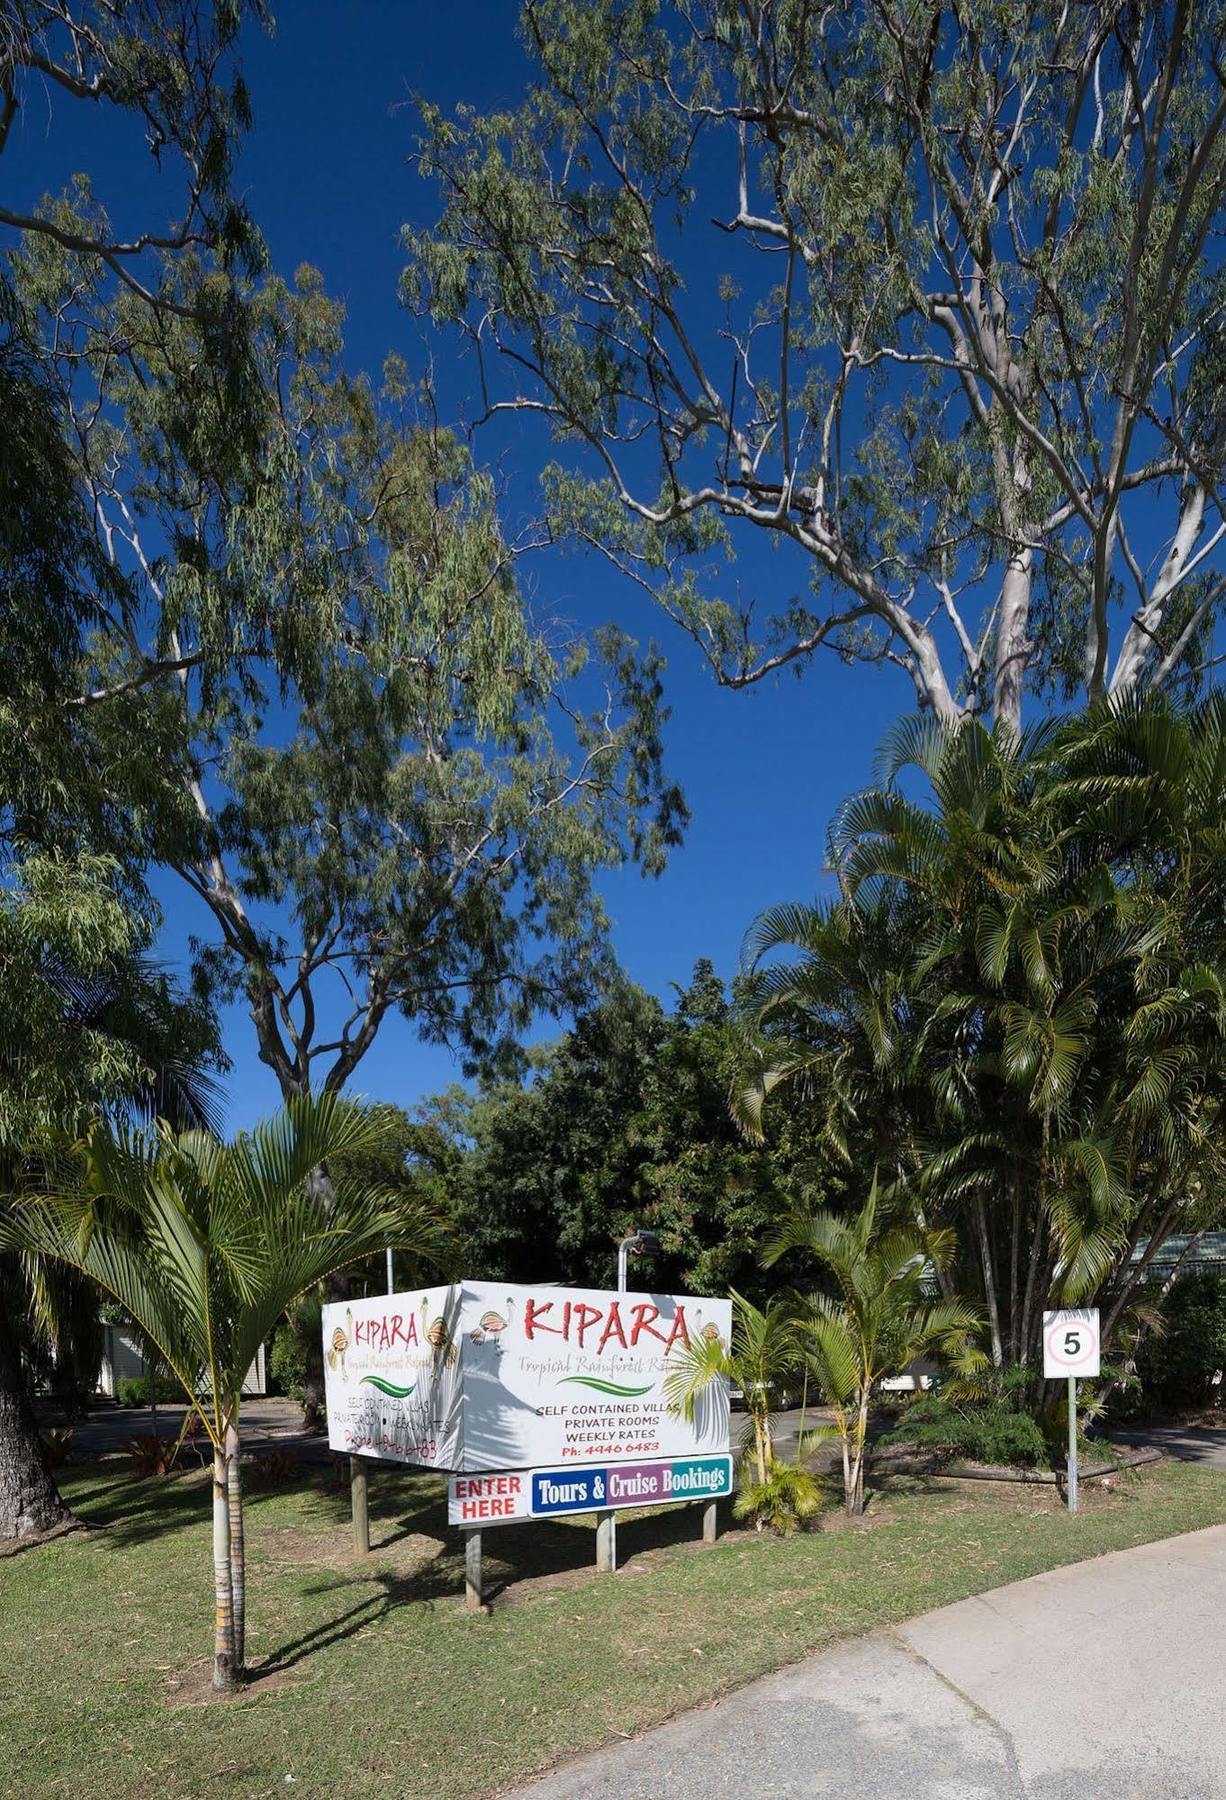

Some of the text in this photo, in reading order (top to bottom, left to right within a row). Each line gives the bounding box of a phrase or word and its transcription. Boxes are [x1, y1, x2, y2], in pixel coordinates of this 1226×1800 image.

[355, 1312, 418, 1353] KIPARA
[524, 1299, 692, 1356] KIPARA
[1064, 1331, 1081, 1355] 5
[519, 1354, 570, 1386] Tropical
[577, 1354, 643, 1379] Rainforest
[535, 1402, 680, 1417] SELF CONTAINED VILLAS
[564, 1416, 660, 1429] PRIVATE ROOMS
[566, 1429, 656, 1442] WEEKLY RATES
[562, 1441, 660, 1456] Ph: 4946 6483
[455, 1475, 522, 1499] ENTER
[538, 1466, 725, 1505] Tours & Cruise Bookings
[461, 1497, 516, 1519] HERE
